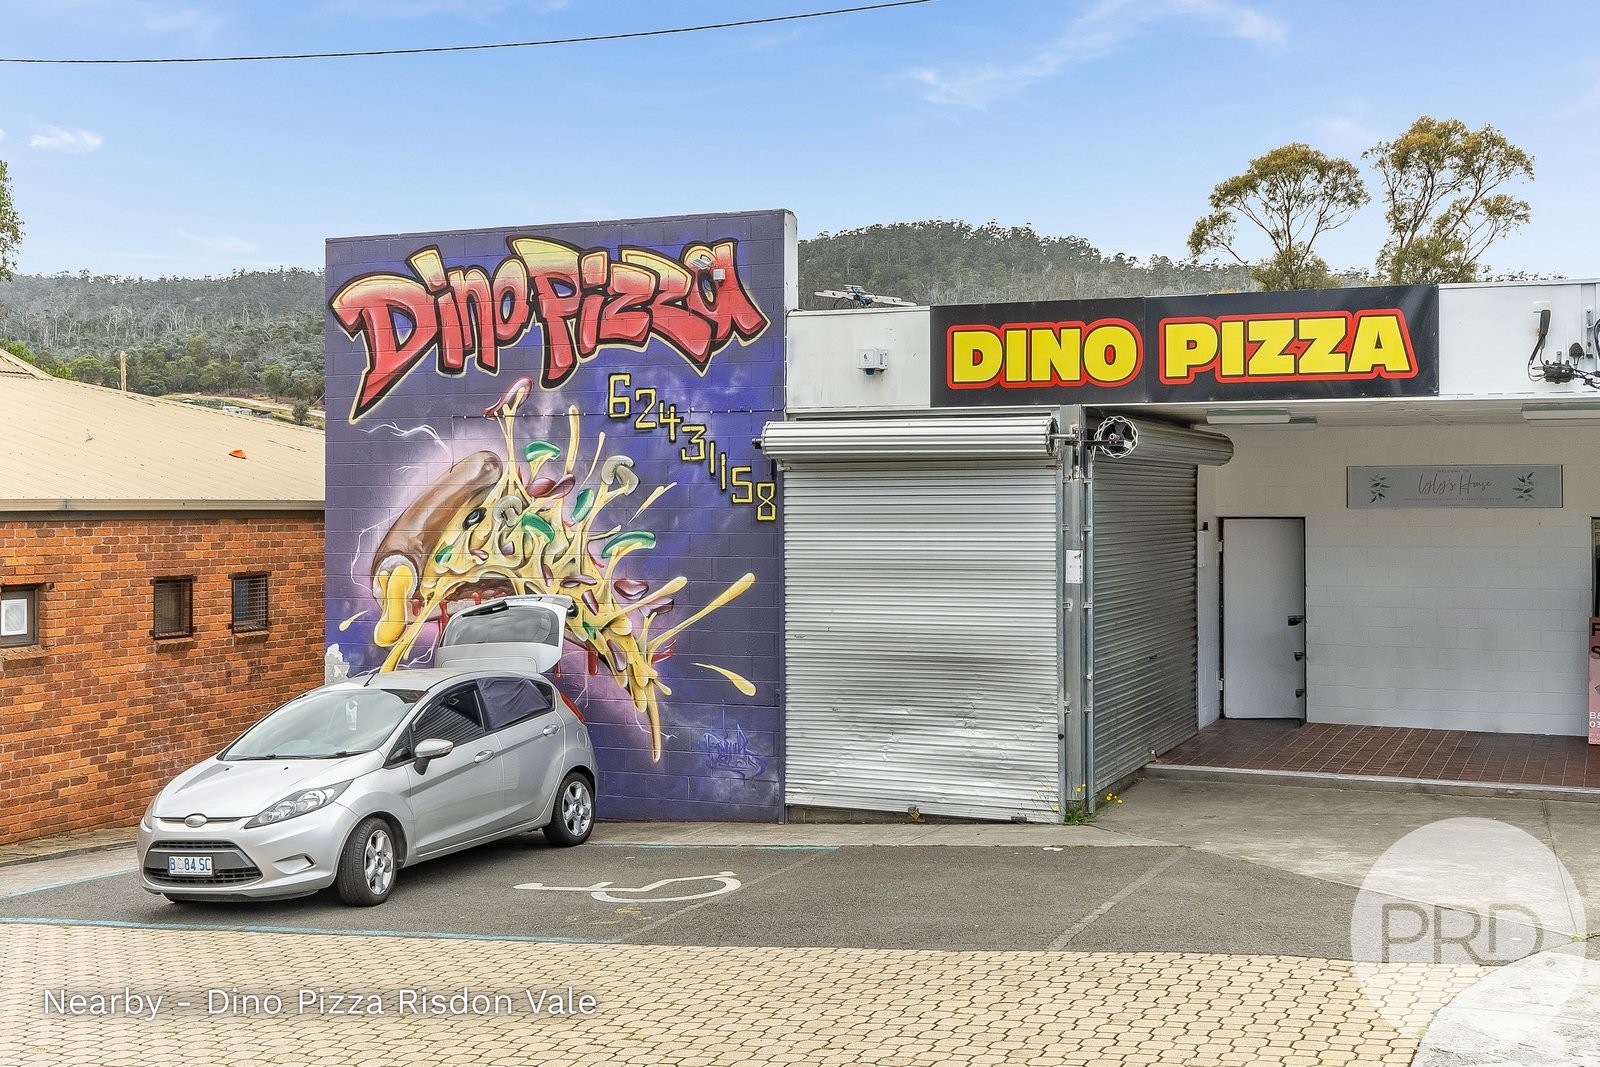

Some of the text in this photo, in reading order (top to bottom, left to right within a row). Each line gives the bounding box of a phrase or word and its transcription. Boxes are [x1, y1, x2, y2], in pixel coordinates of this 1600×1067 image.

[331, 235, 771, 424] Dino Pizza
[950, 310, 1417, 386] DINO PIZZA
[1459, 473, 1492, 496] House
